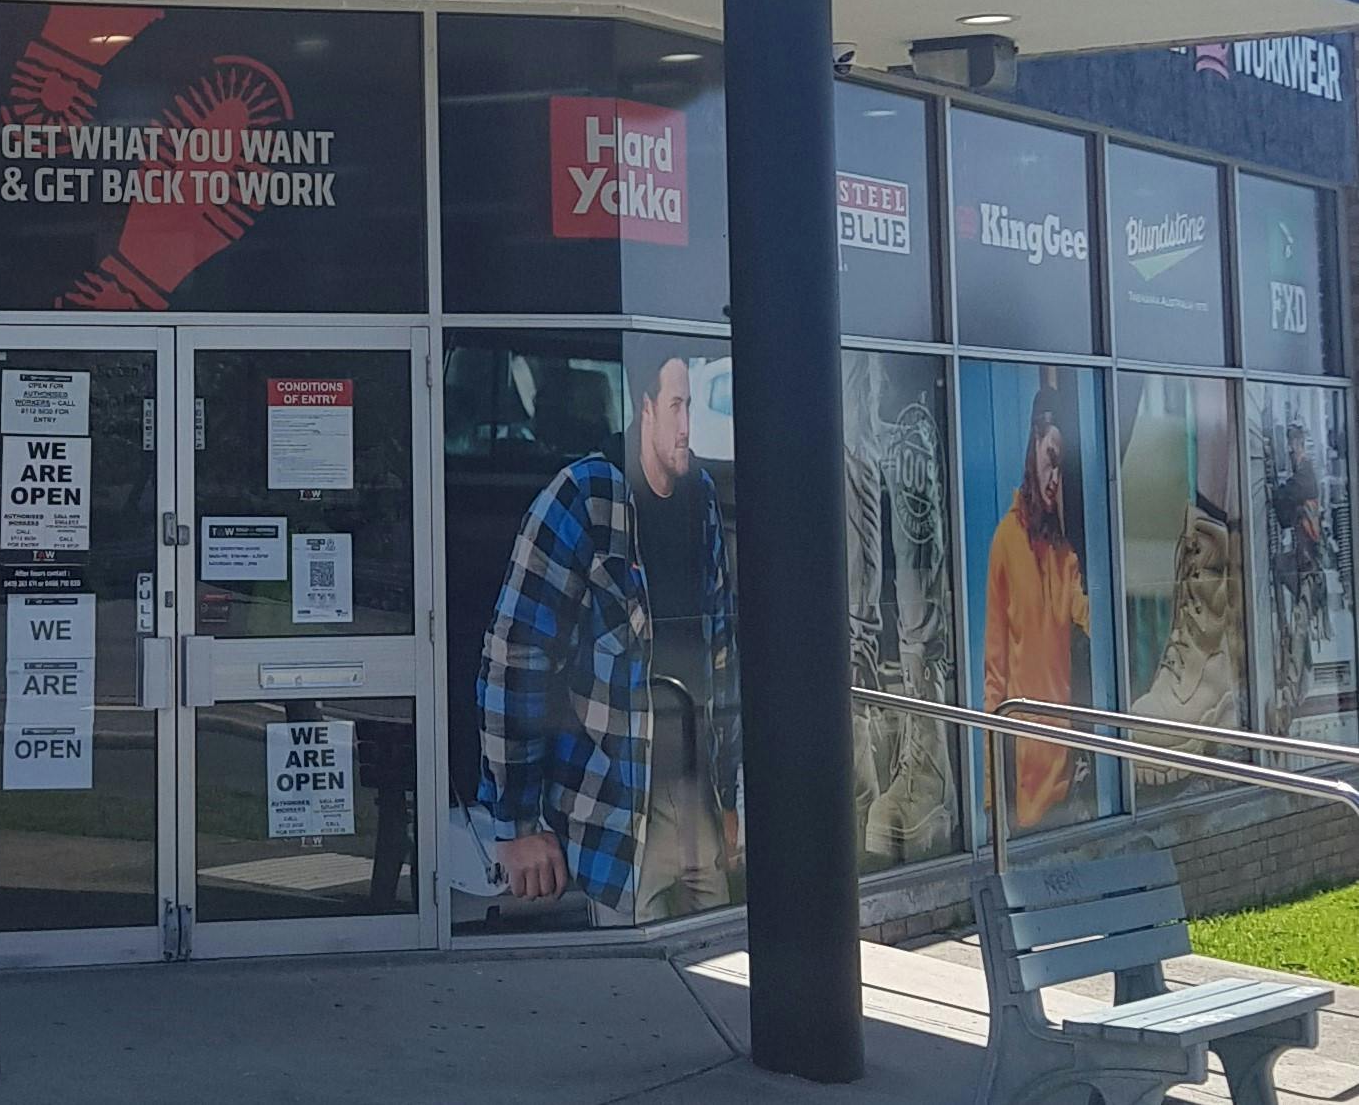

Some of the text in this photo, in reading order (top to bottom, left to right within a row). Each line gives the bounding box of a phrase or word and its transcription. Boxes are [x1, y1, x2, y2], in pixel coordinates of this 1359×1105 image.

[1234, 35, 1342, 102] WORKWEAR
[1, 124, 335, 165] GET WHAT YOU WANT
[585, 116, 673, 174] Hard
[0, 166, 336, 207] & GET BACK TO WORK
[567, 167, 682, 224] Yakka
[839, 180, 906, 213] STEEL
[840, 211, 906, 249] BLUE
[980, 202, 1088, 266] KingGee
[1125, 212, 1205, 256] Blundstone
[1269, 280, 1307, 334] FXD
[277, 381, 344, 392] CONDITIONS
[283, 395, 338, 405] OF ENTRY
[27, 441, 67, 460] WE
[20, 464, 73, 483] ARE
[10, 486, 81, 505] OPEN
[139, 575, 151, 629] PULL
[29, 619, 72, 641] WE
[22, 674, 78, 695] ARE
[14, 739, 82, 759] OPEN
[290, 726, 329, 745] WE
[285, 749, 336, 769] ARE
[276, 770, 345, 792] OPEN
